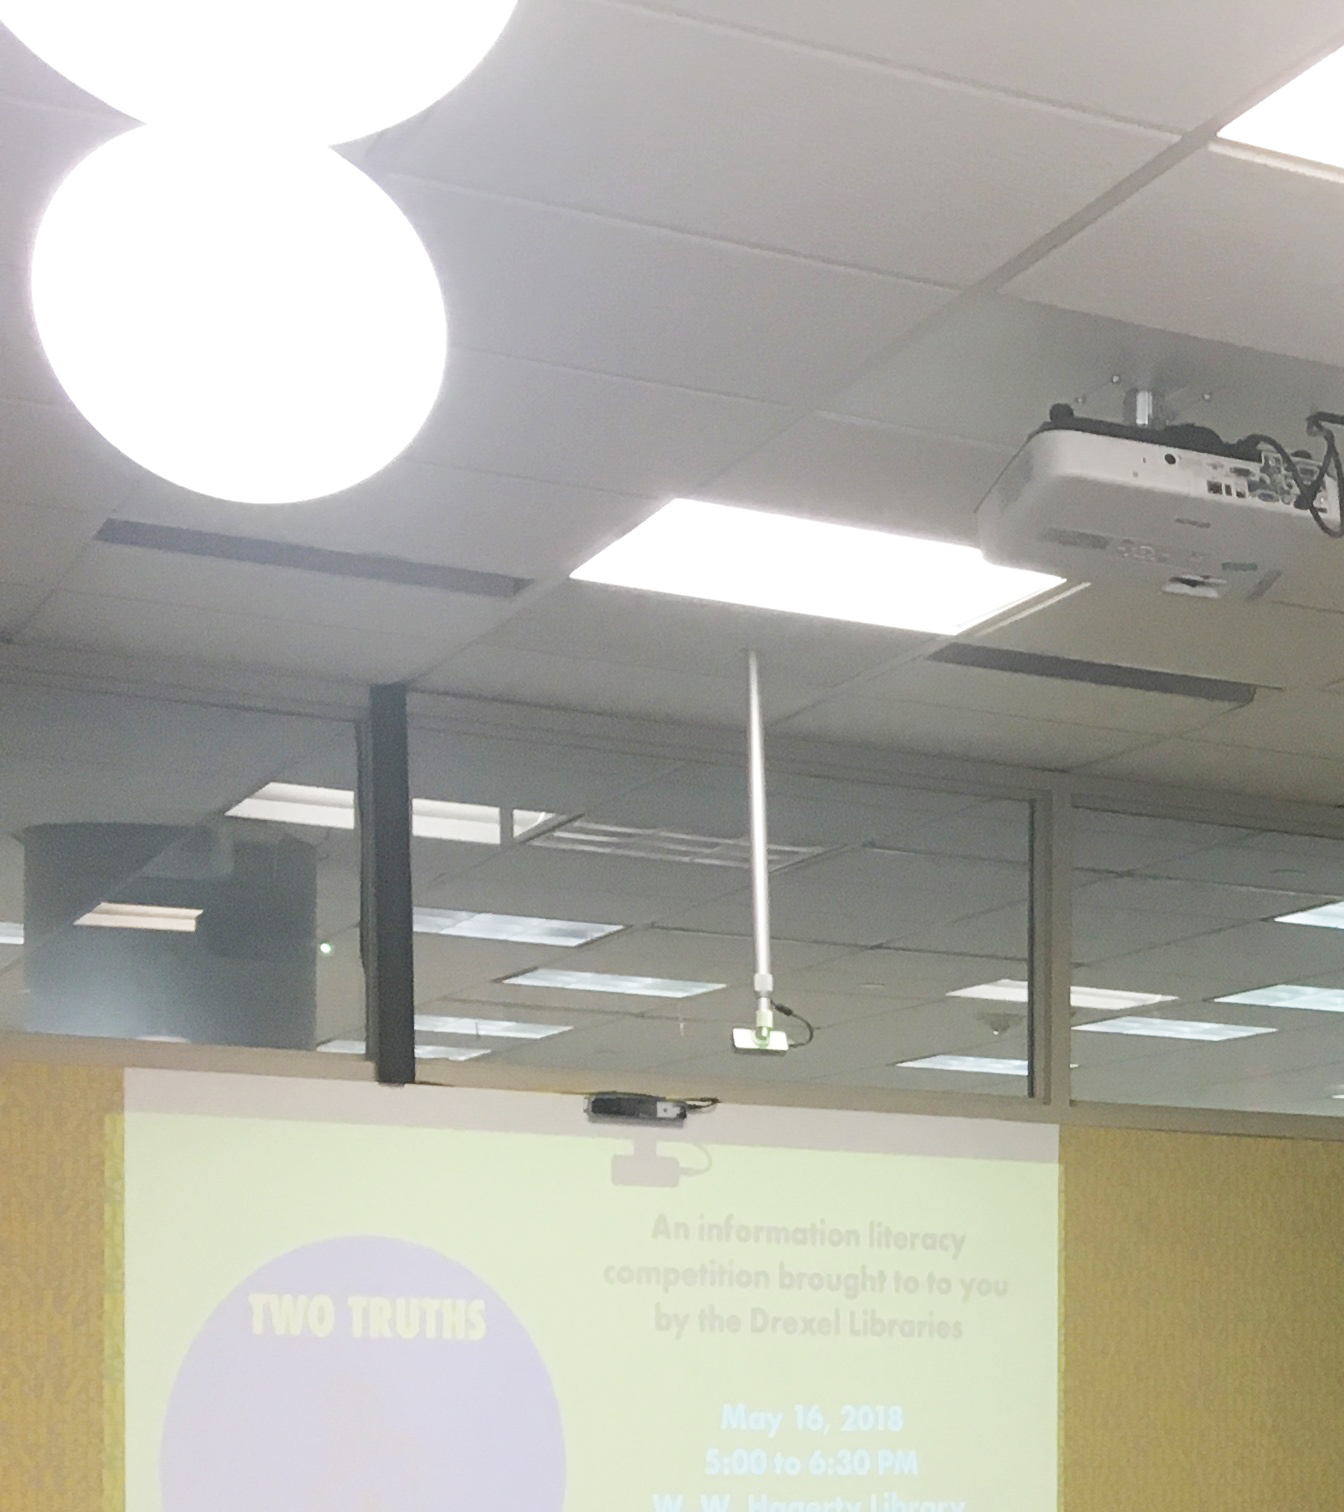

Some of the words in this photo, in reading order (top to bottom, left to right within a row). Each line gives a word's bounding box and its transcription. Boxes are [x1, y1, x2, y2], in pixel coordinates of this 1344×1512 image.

[651, 1212, 690, 1242] An
[697, 1212, 861, 1248] information
[868, 1219, 966, 1260] literacy
[602, 1259, 771, 1294] competition
[777, 1261, 888, 1301] brought
[893, 1269, 920, 1295] to
[926, 1270, 953, 1297] to
[958, 1277, 1010, 1304] you
[248, 1292, 336, 1338] TWO
[347, 1295, 487, 1341] TRUTHS
[653, 1301, 690, 1340] by
[697, 1303, 742, 1334] the
[749, 1306, 841, 1338] Drexel
[848, 1309, 965, 1340] Libraries
[720, 1402, 784, 1439] May
[793, 1404, 832, 1437] 16,
[840, 1404, 905, 1433] 2018
[704, 1447, 768, 1476] 5:00
[772, 1451, 802, 1476] to
[808, 1448, 871, 1476] 6:30
[877, 1448, 919, 1476] PM
